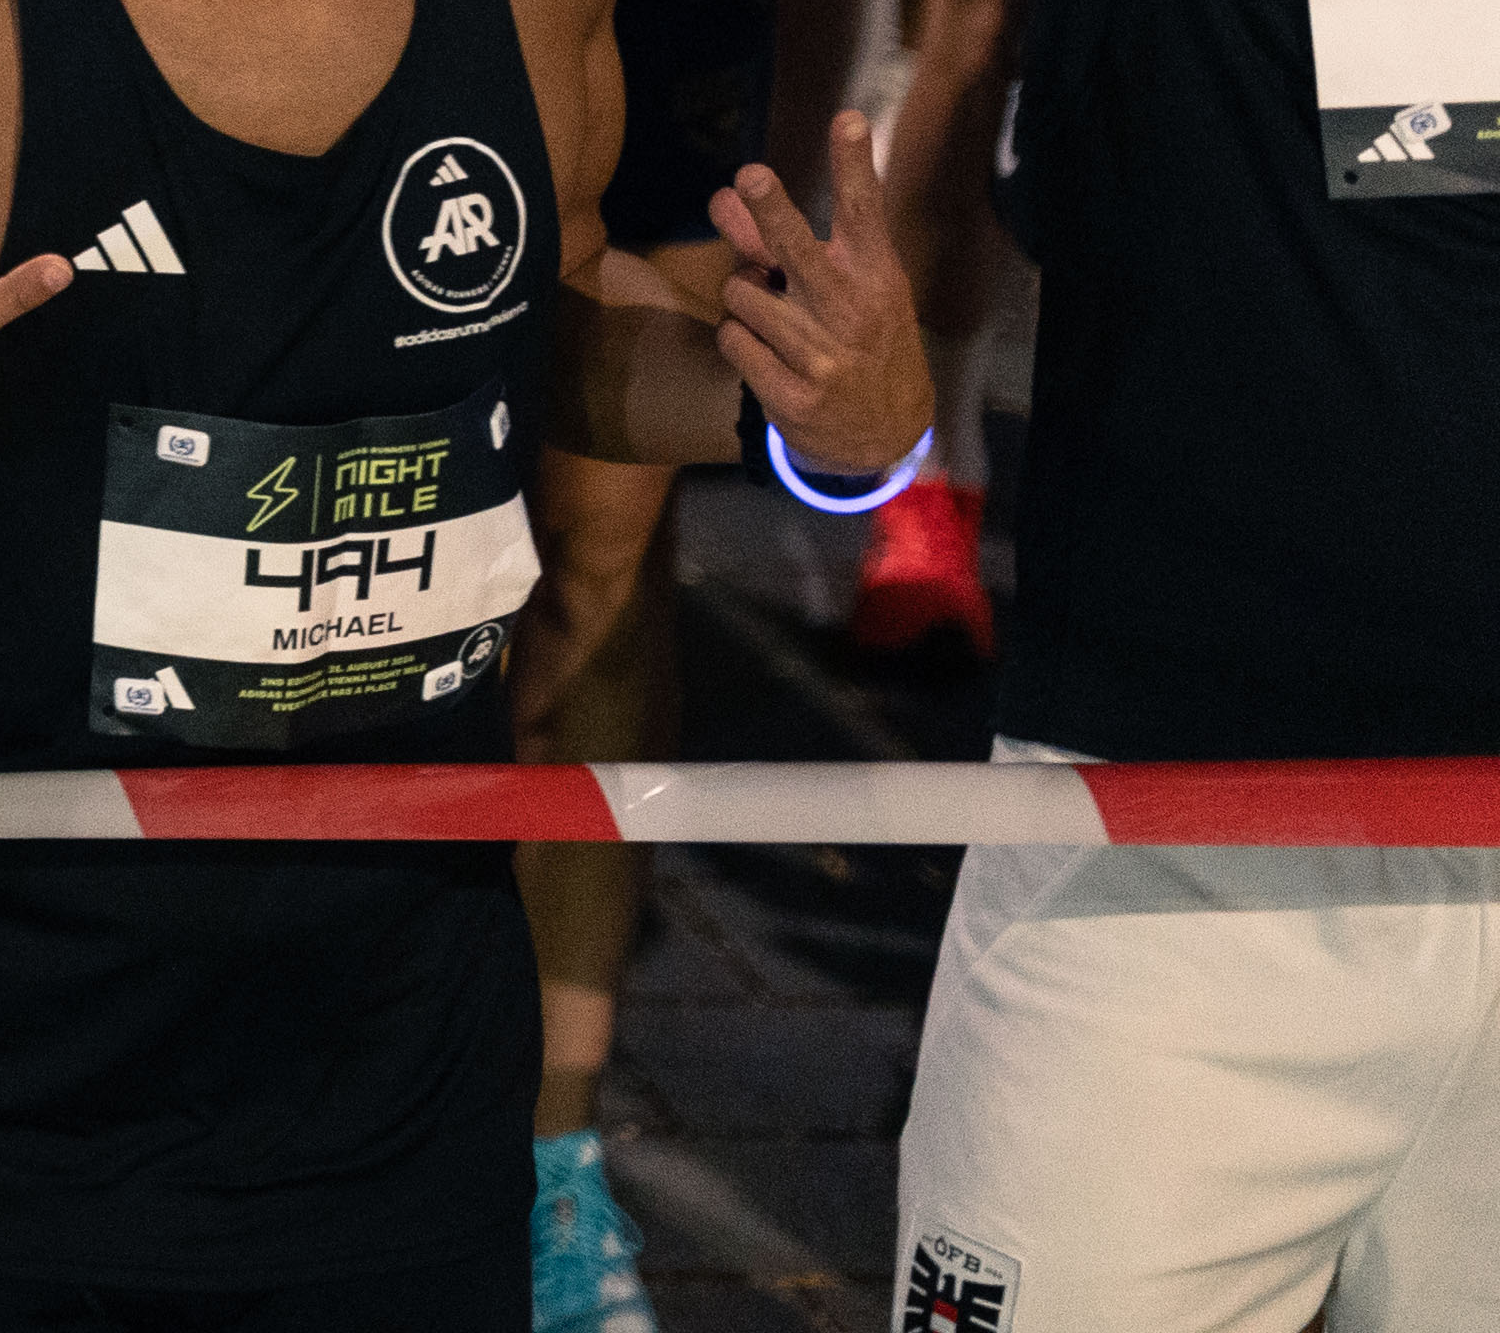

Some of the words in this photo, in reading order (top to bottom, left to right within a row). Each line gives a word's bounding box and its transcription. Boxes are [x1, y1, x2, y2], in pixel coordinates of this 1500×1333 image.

[419, 192, 500, 264] AR
[335, 450, 449, 491] NIGHT
[334, 484, 438, 523] MILE
[245, 530, 436, 613] 494
[273, 612, 403, 651] MICHAEL
